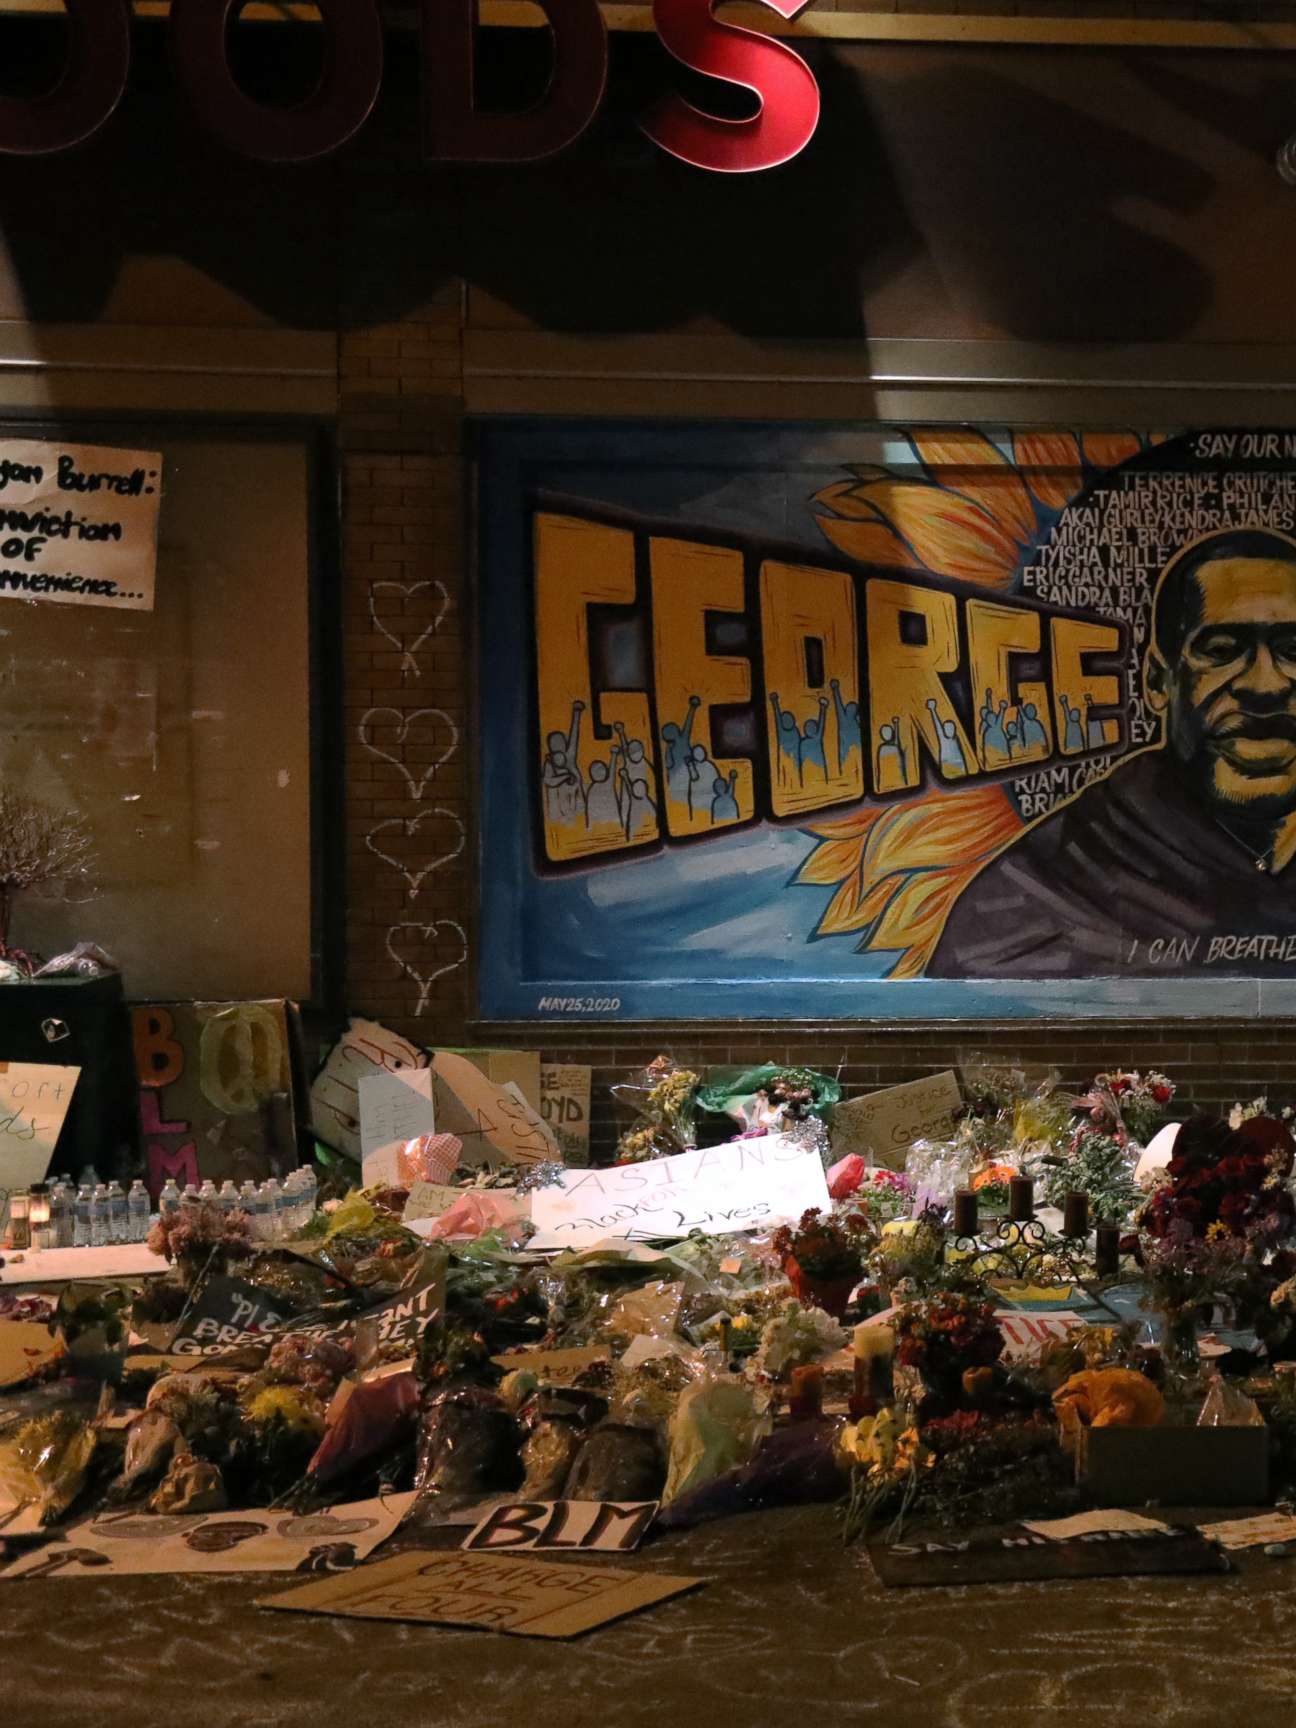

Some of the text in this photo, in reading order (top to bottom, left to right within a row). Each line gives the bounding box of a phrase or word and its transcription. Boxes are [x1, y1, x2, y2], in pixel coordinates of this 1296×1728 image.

[1196, 433, 1239, 458] SAY
[1241, 434, 1284, 458] OUR
[1120, 472, 1219, 494] TERRENCE
[1094, 490, 1155, 510] TAMIR
[1156, 492, 1207, 511] RICE
[1059, 507, 1100, 528] AKAI
[1233, 509, 1295, 529] JAMES
[1051, 526, 1133, 546] MICHAEL
[1036, 545, 1102, 569] TYISHA
[1023, 566, 1066, 587] ERIC
[1067, 567, 1151, 588] GARNER
[1036, 585, 1113, 607] SANDRA
[533, 511, 1121, 863] GEORGE
[1127, 939, 1139, 963] I
[1149, 934, 1200, 964] CAN
[564, 1137, 803, 1197] ASIANS
[468, 1501, 658, 1550] BLM
